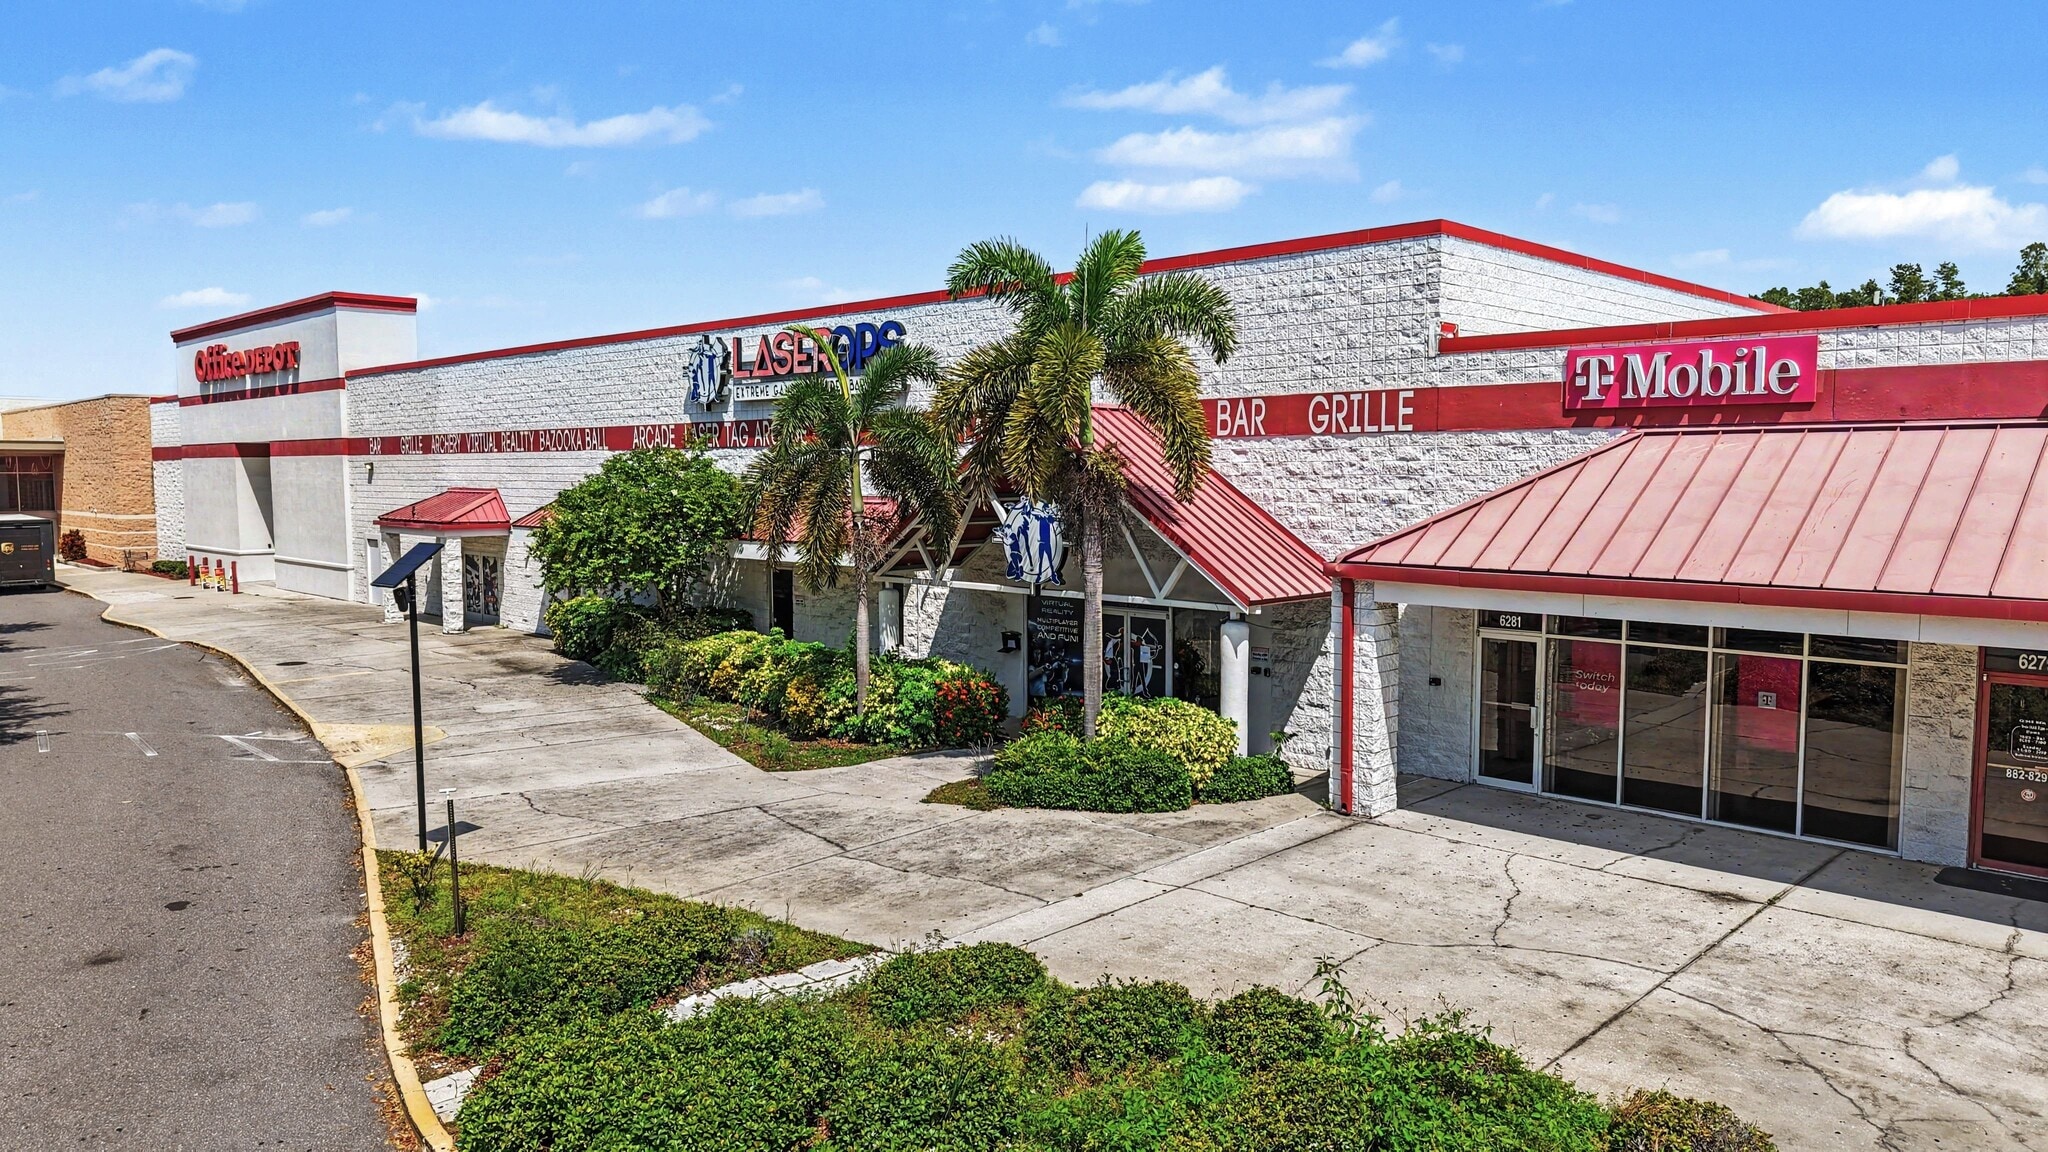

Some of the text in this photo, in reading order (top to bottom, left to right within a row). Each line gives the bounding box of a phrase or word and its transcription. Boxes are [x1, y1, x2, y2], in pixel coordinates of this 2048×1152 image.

[195, 341, 300, 383] Office DEPOT
[736, 385, 769, 399] EXTREME
[1216, 390, 1414, 436] BAR GRILLE
[369, 438, 381, 454] BAR
[400, 436, 422, 454] GRILLE
[431, 433, 461, 454] ARCHERY
[465, 432, 498, 453] VIRTUAL
[501, 431, 535, 452] REALITY
[539, 429, 583, 451] BAZOOKA
[585, 427, 608, 450] BALL
[633, 424, 675, 449] ARCADE
[724, 421, 749, 447] TAG
[1041, 600, 1074, 608] VIRTUAL
[1041, 607, 1073, 615] REALITY
[1036, 617, 1078, 626] MULTIPLAYER
[1499, 614, 1521, 628] 6281
[1036, 624, 1078, 634] COMPETITIVE
[1037, 631, 1056, 640] AND
[2018, 653, 2048, 671] 627
[1575, 669, 1615, 682] Switch
[1575, 681, 1611, 694] today
